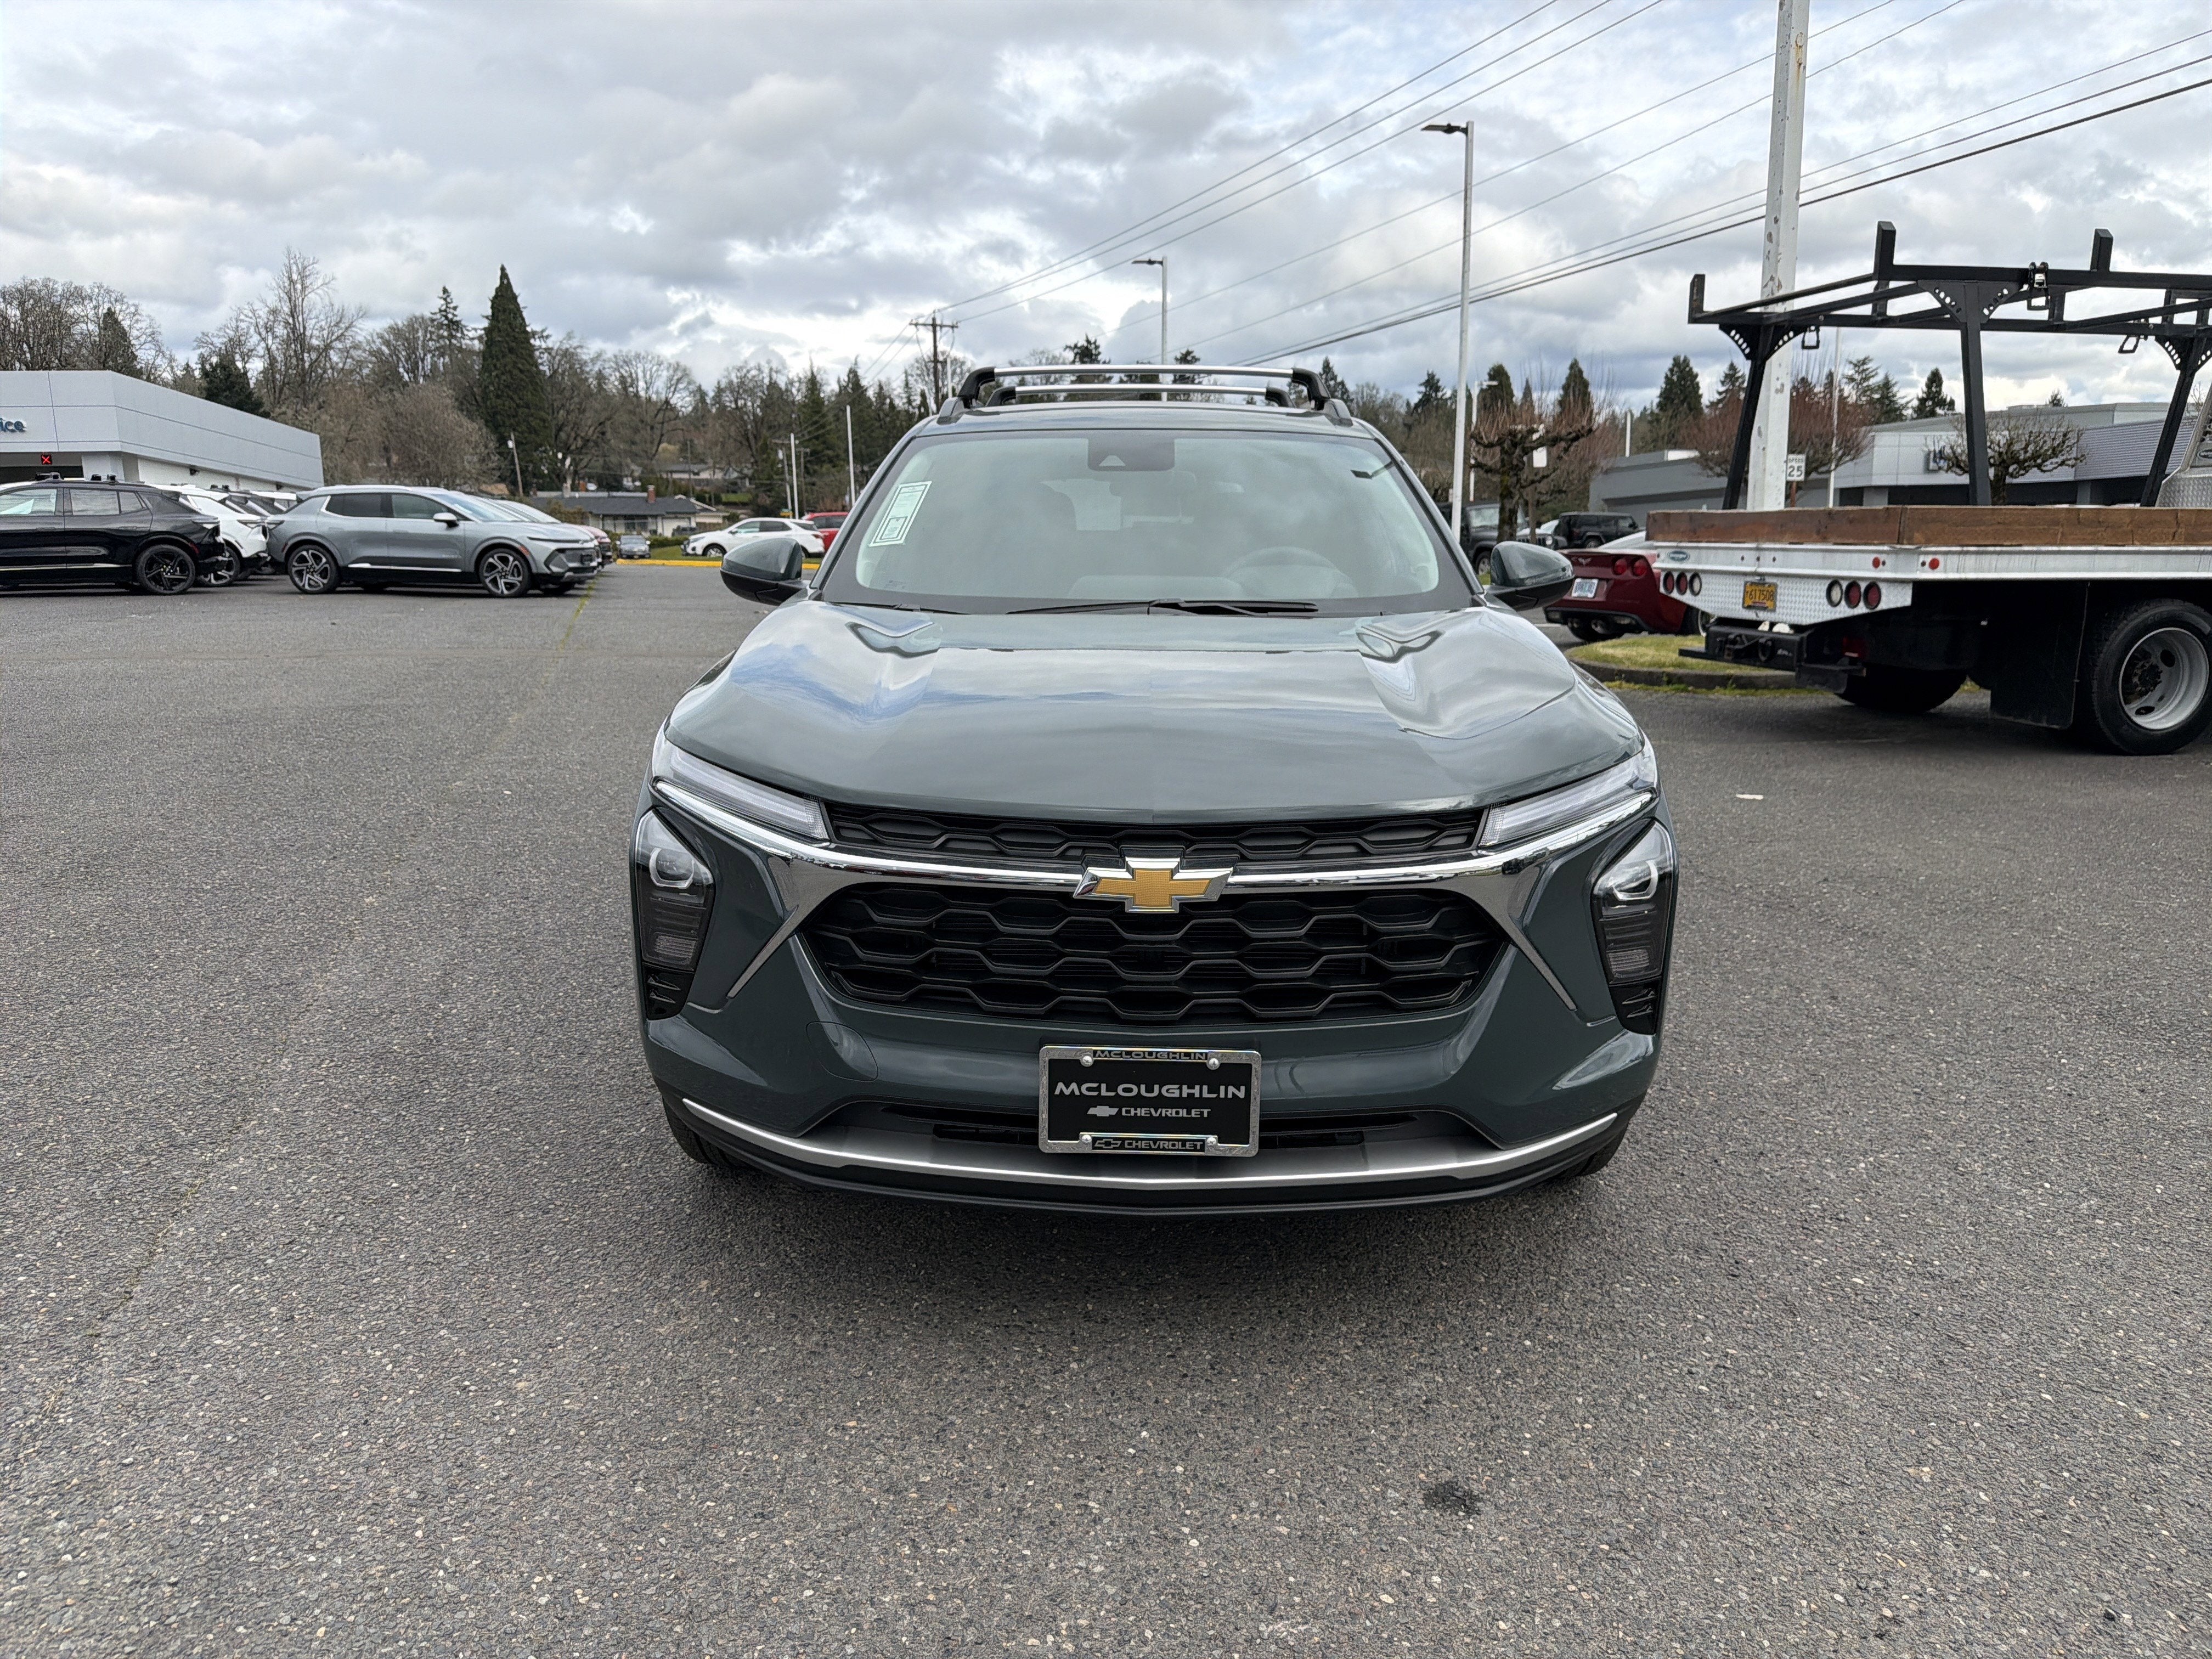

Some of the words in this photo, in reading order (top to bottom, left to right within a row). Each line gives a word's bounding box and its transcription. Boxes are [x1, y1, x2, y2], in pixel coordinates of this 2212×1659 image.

[1788, 465, 1803, 478] 25
[1095, 1049, 1207, 1060] MCLOUGHLIN
[1054, 1082, 1246, 1099] MCLOUGHLIN
[1121, 1107, 1211, 1118] CHEVROLET
[1124, 1140, 1204, 1150] CHEVROLET
